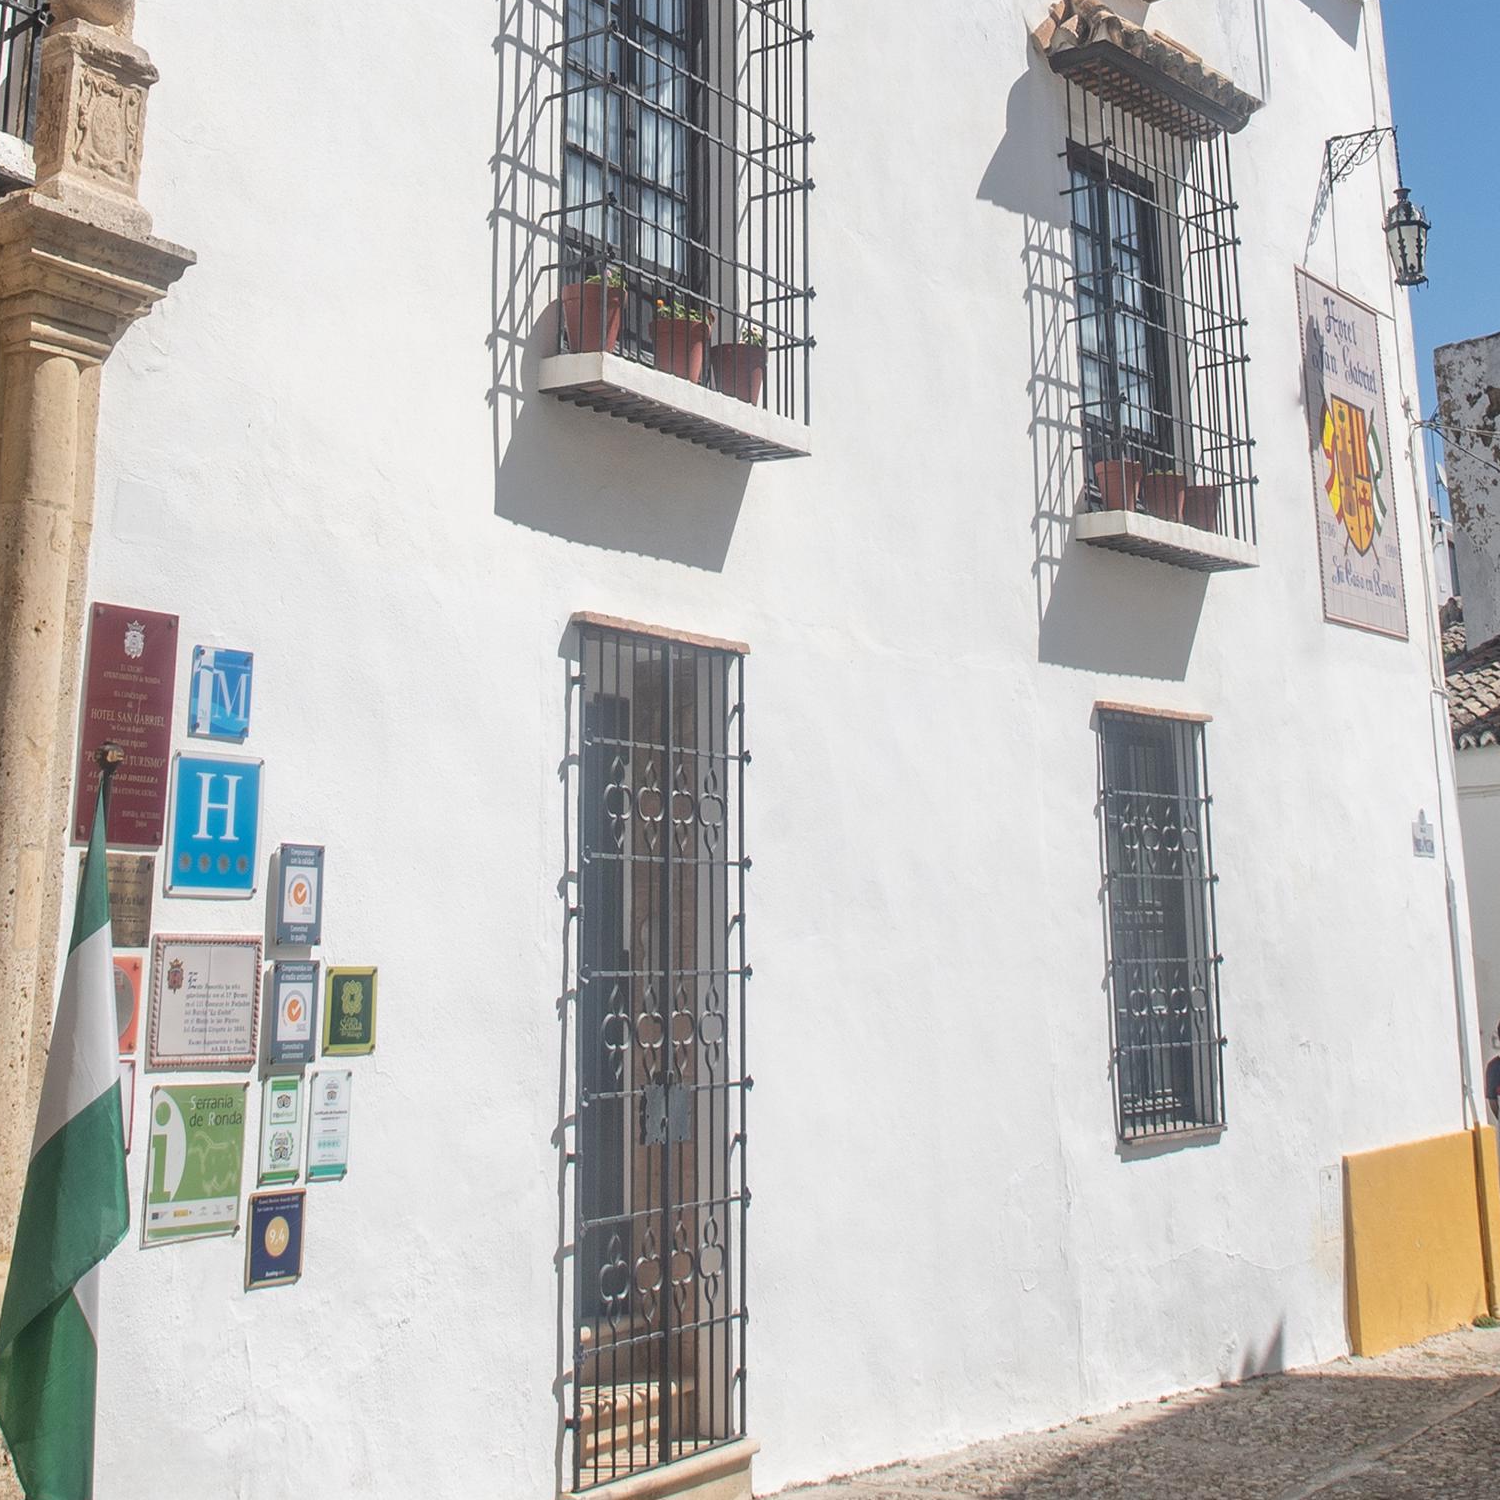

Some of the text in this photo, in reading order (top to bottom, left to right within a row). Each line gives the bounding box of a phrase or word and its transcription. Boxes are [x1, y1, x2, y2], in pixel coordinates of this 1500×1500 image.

[1323, 296, 1357, 346] Hotel
[1311, 342, 1378, 395] San Gabriel
[1344, 558, 1365, 589] Casa
[1372, 568, 1397, 599] Ronda
[91, 708, 165, 727] HOTEL SAN GABRIEL
[212, 668, 252, 722] M
[191, 771, 244, 841] H
[189, 1110, 242, 1128] de Ronda
[269, 1227, 286, 1245] 9,4
